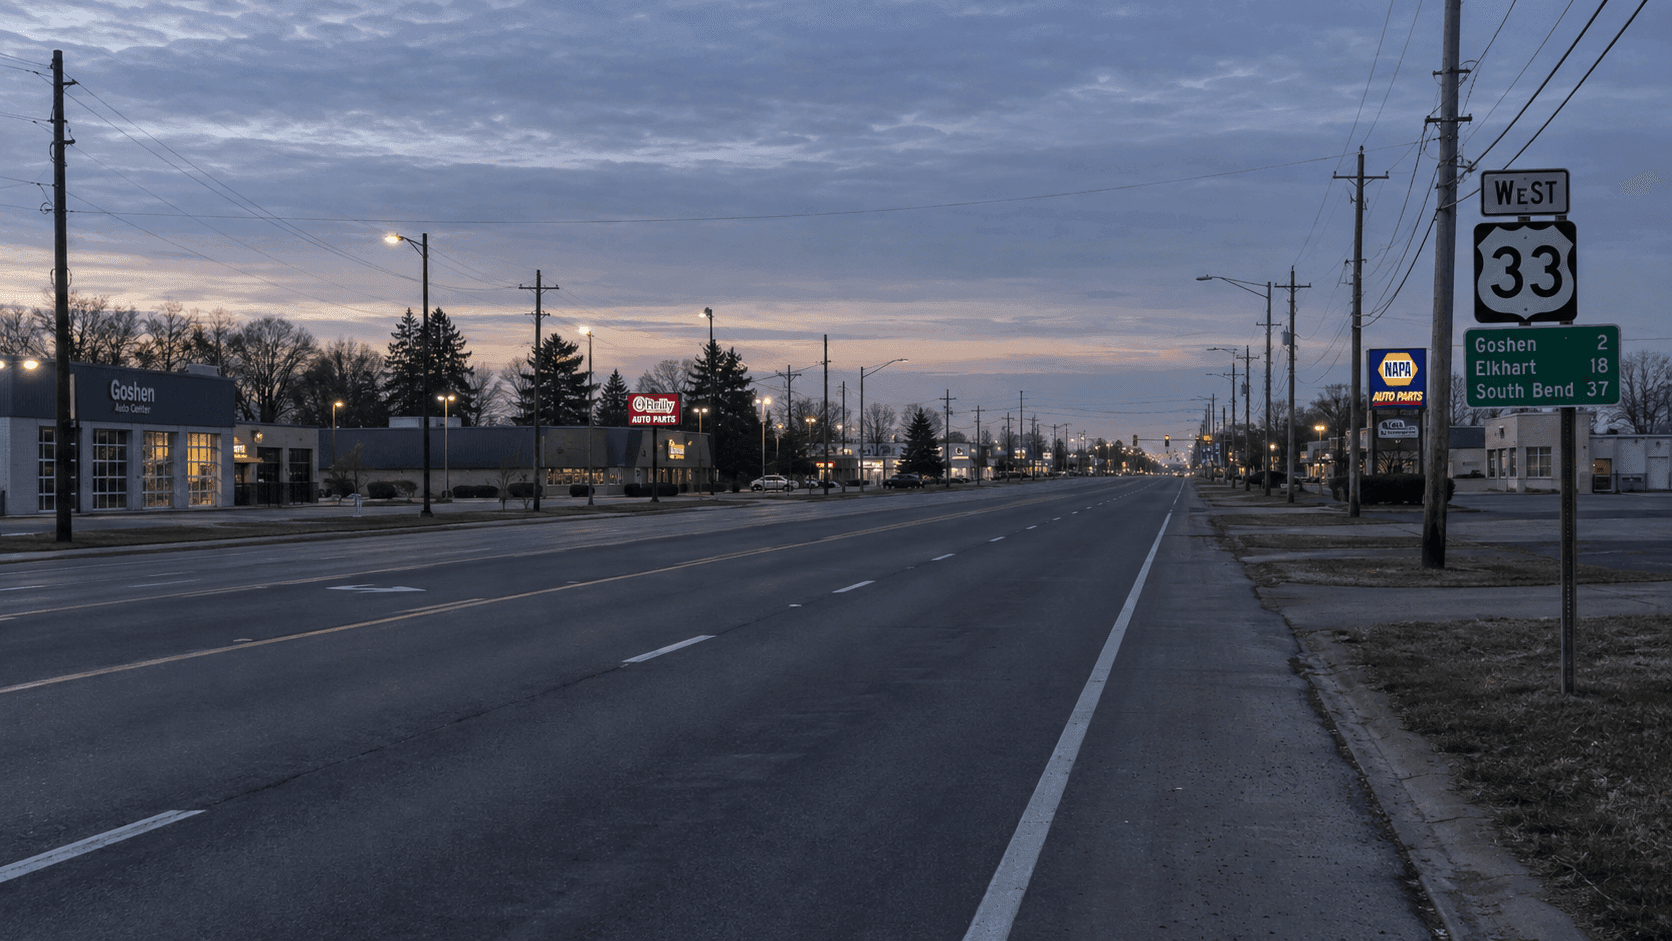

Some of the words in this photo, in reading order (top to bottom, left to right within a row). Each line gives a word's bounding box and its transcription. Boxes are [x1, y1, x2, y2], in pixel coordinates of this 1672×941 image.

[1495, 180, 1557, 205] WEST
[1490, 244, 1563, 299] 33
[1475, 337, 1537, 353] Goshen
[1596, 334, 1608, 350] 2
[1385, 361, 1411, 377] NAPA
[1475, 360, 1537, 376] Elkhart
[1590, 357, 1609, 373] 18
[111, 379, 155, 402] Goshen
[1372, 391, 1395, 402] AUTO
[1396, 391, 1423, 402] PARTS
[1476, 383, 1524, 399] South
[1532, 382, 1574, 398] Bend
[1586, 381, 1609, 397] 37
[115, 402, 130, 413] Auto
[130, 403, 151, 414] Center
[632, 415, 651, 424] AUTO
[653, 415, 676, 424] PARTS
